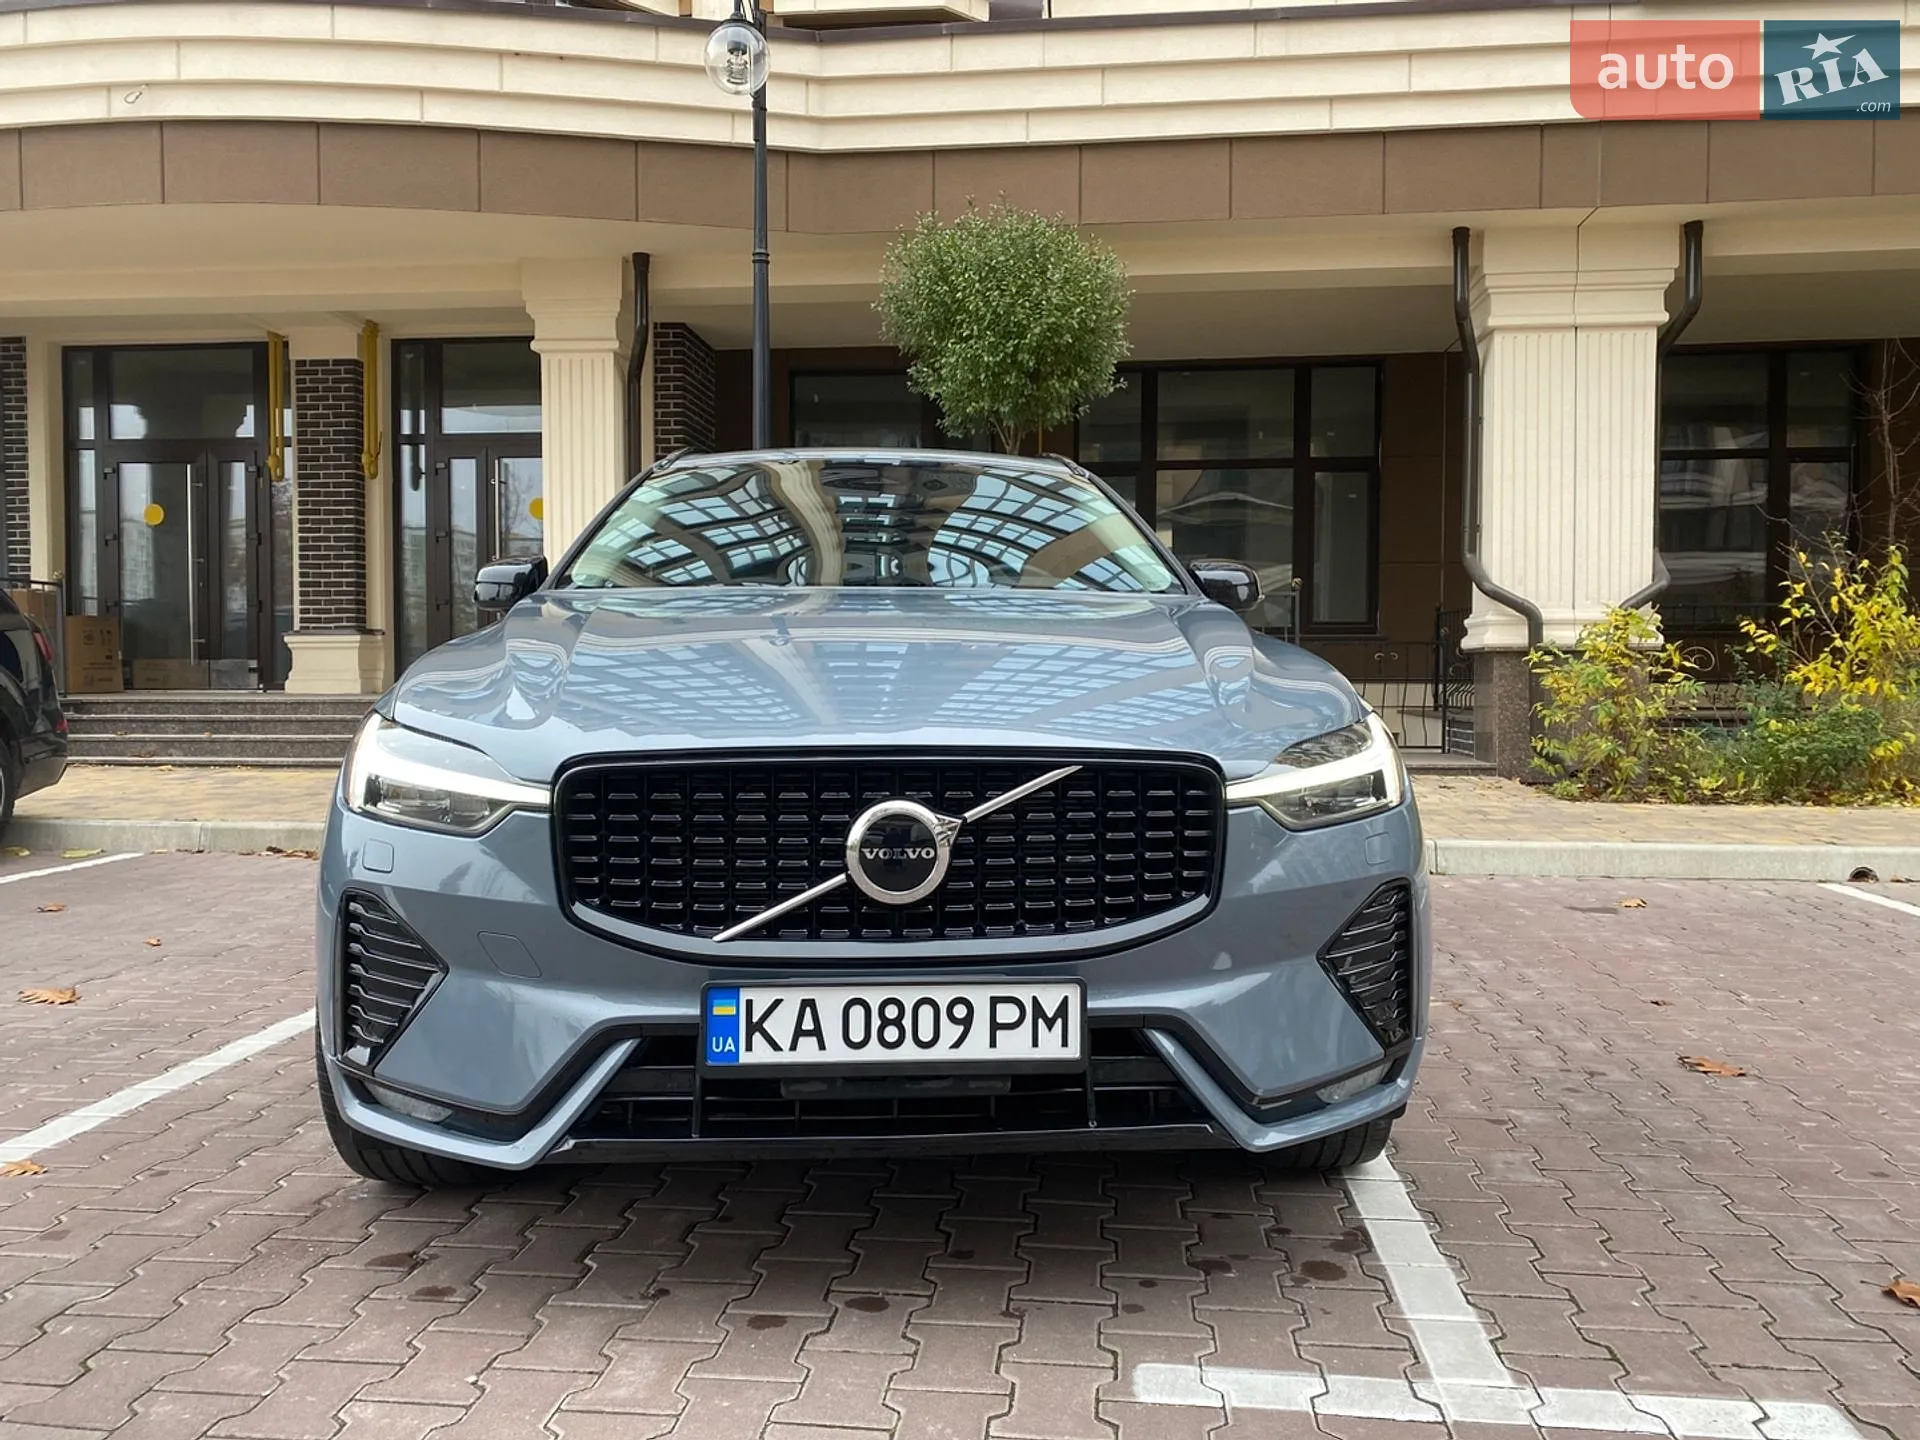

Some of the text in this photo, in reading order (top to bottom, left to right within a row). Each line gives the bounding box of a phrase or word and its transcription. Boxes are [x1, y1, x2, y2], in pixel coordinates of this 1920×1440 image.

[861, 847, 935, 859] VOLVO
[745, 995, 1069, 1052] KA 0809 PM
[712, 1037, 735, 1053] UA
